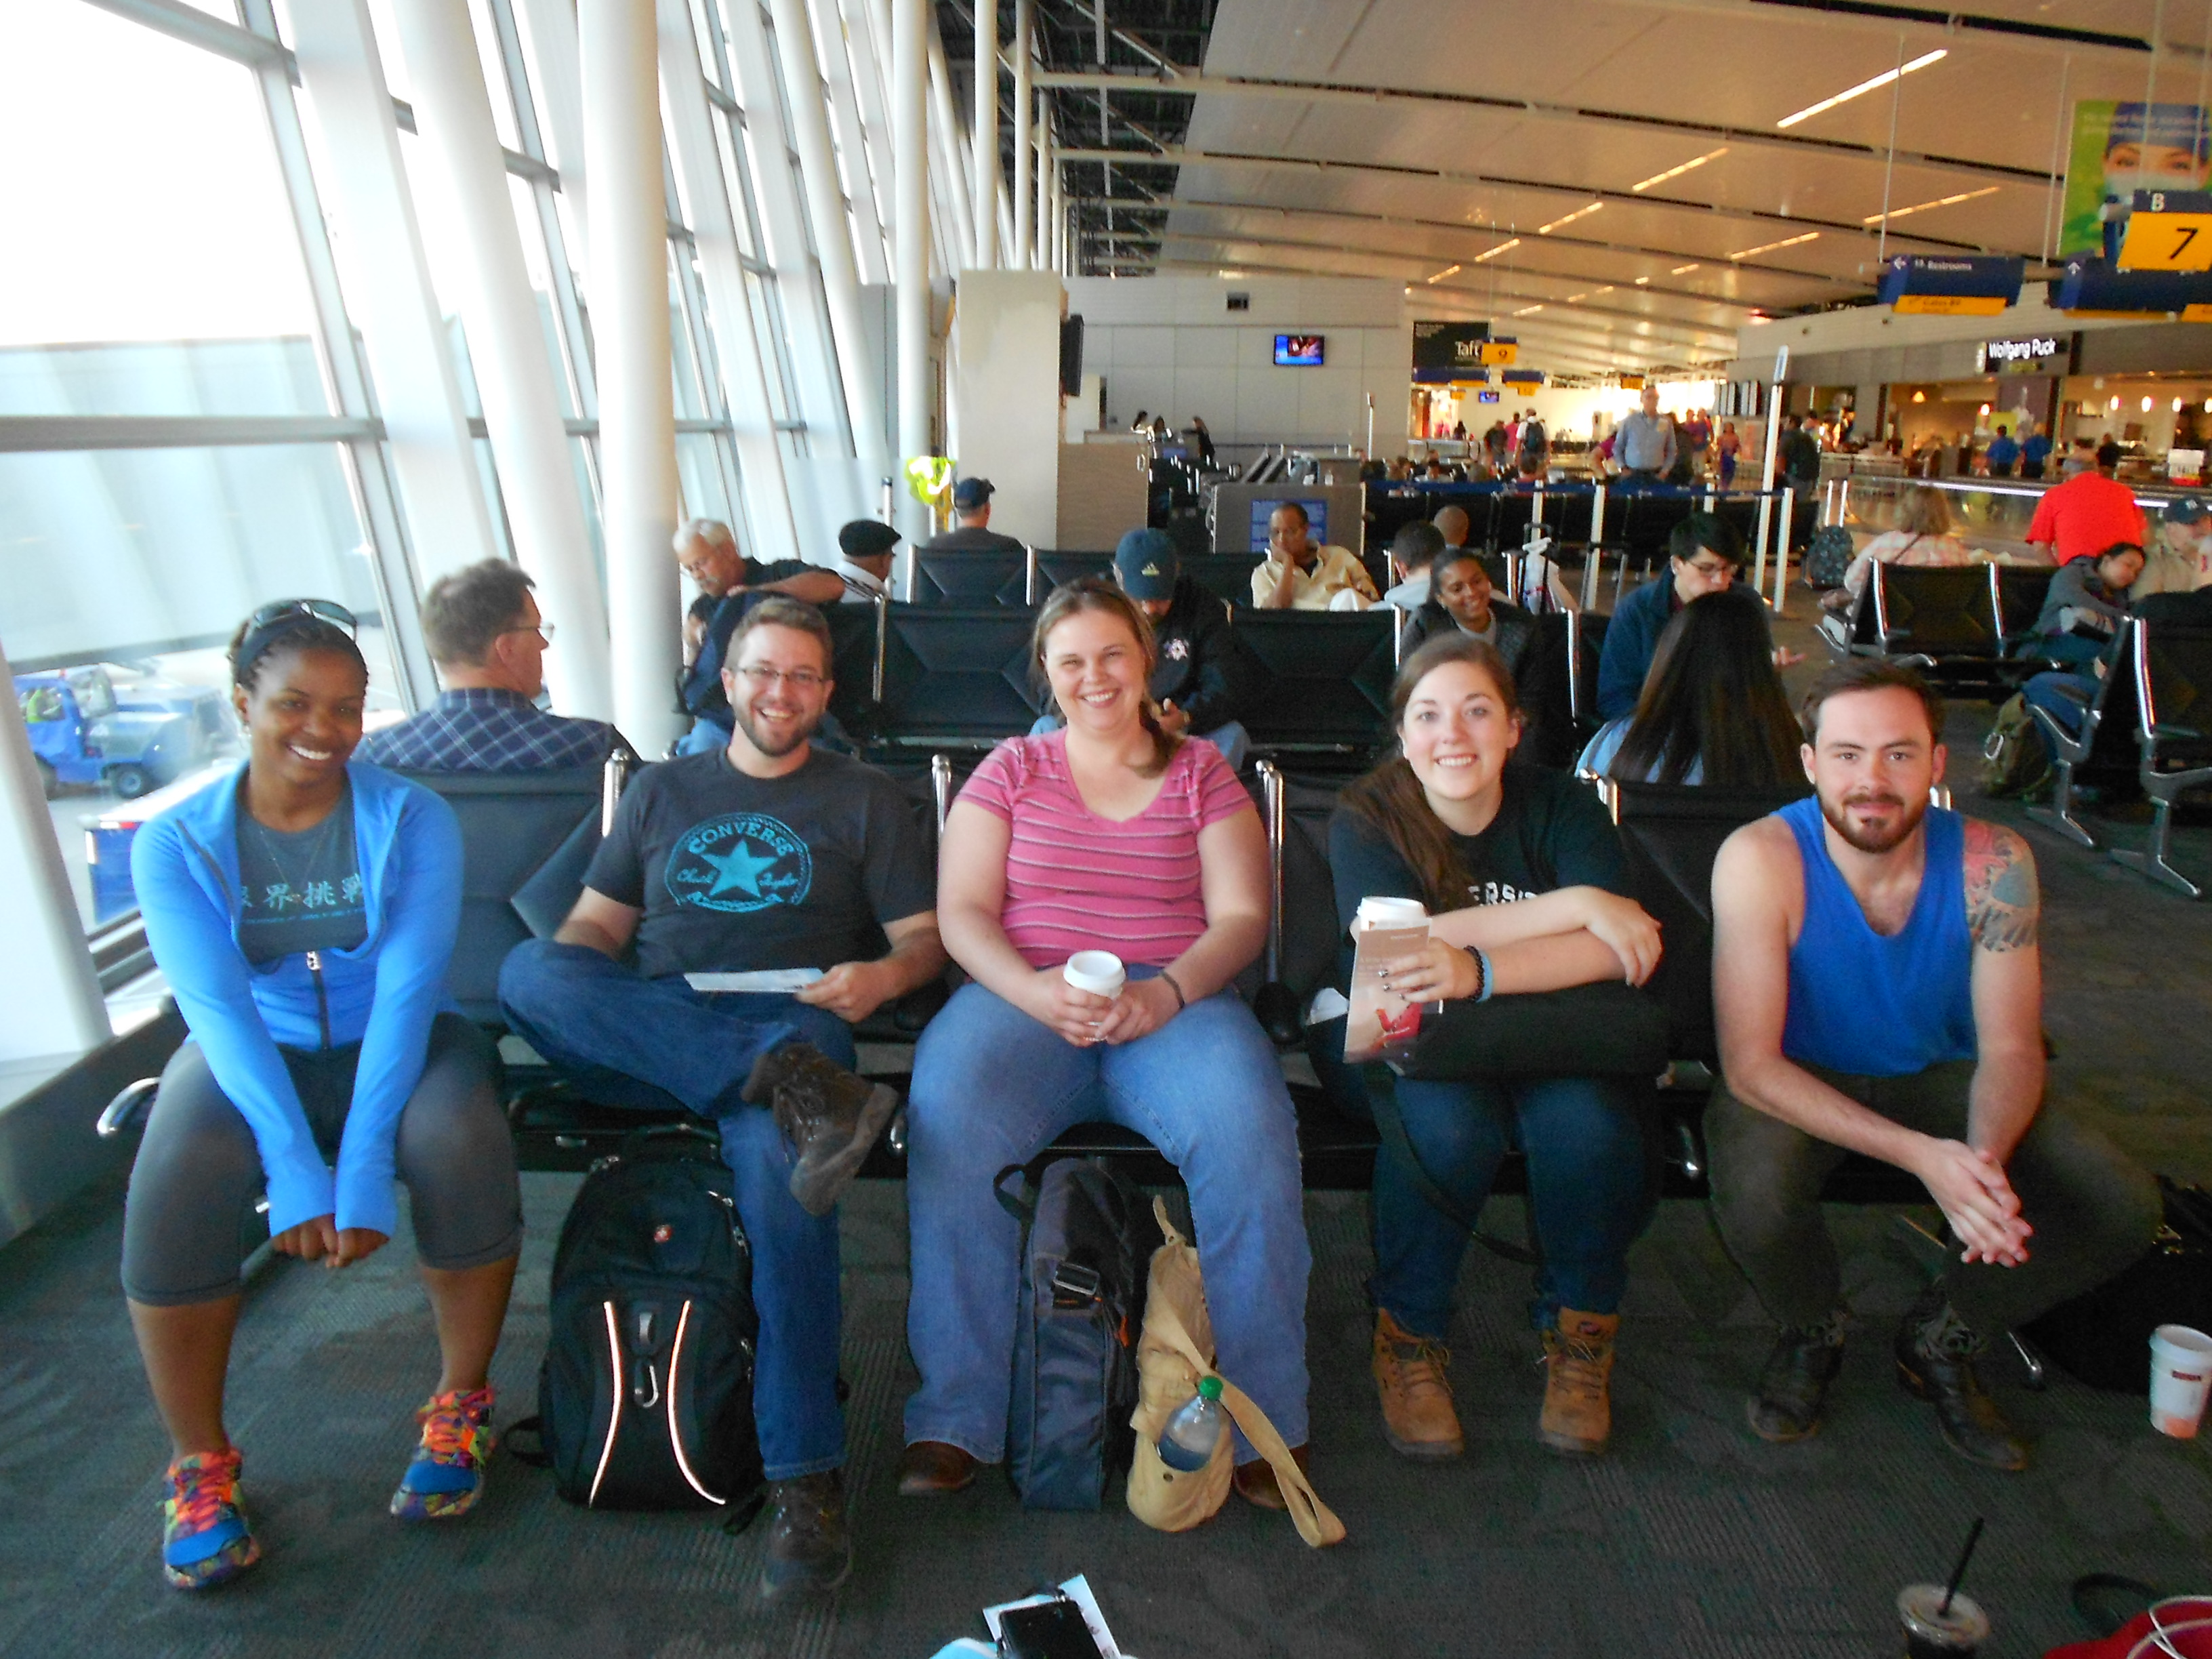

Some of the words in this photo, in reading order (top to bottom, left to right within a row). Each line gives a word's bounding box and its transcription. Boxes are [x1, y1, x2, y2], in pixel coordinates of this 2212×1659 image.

[2150, 192, 2165, 211] B
[2170, 227, 2198, 260] 7
[1988, 340, 2030, 361] Wolfgang
[2032, 337, 2056, 356] Puck
[688, 821, 794, 857] CONVERSE
